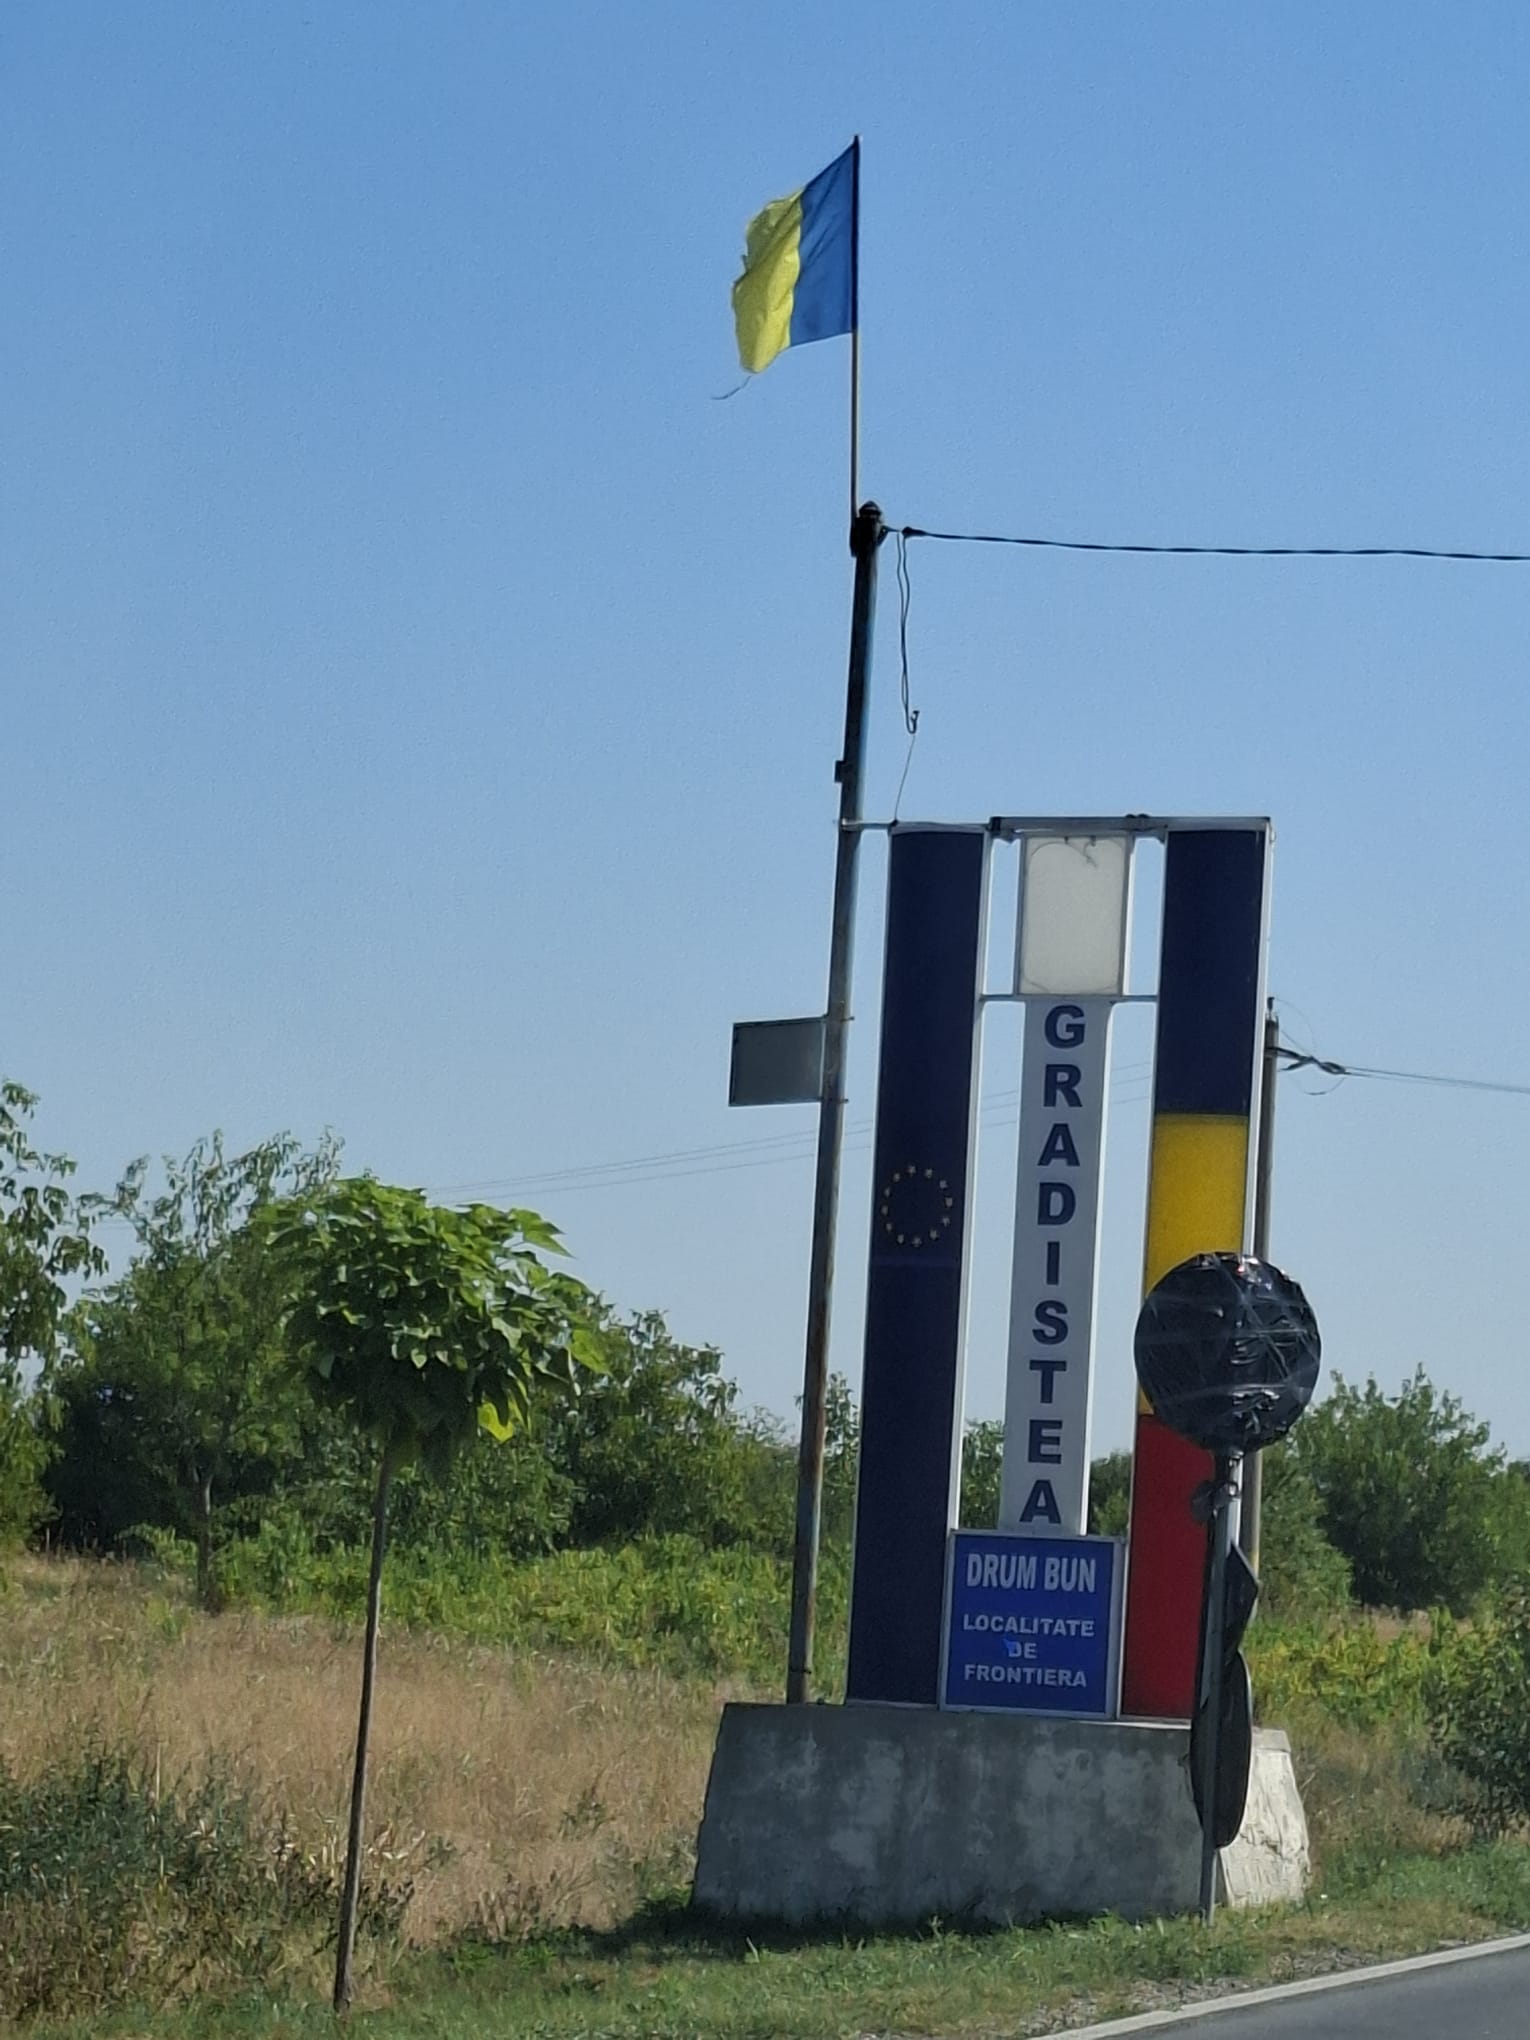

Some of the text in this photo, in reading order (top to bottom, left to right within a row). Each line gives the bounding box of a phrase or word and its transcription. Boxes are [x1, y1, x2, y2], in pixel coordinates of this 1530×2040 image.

[1018, 1004, 1086, 1524] GRADISTEA
[966, 1553, 1096, 1592] DRUM BUN
[963, 1614, 1095, 1637] LOCALITATE
[964, 1664, 1087, 1688] FRONTIERA
